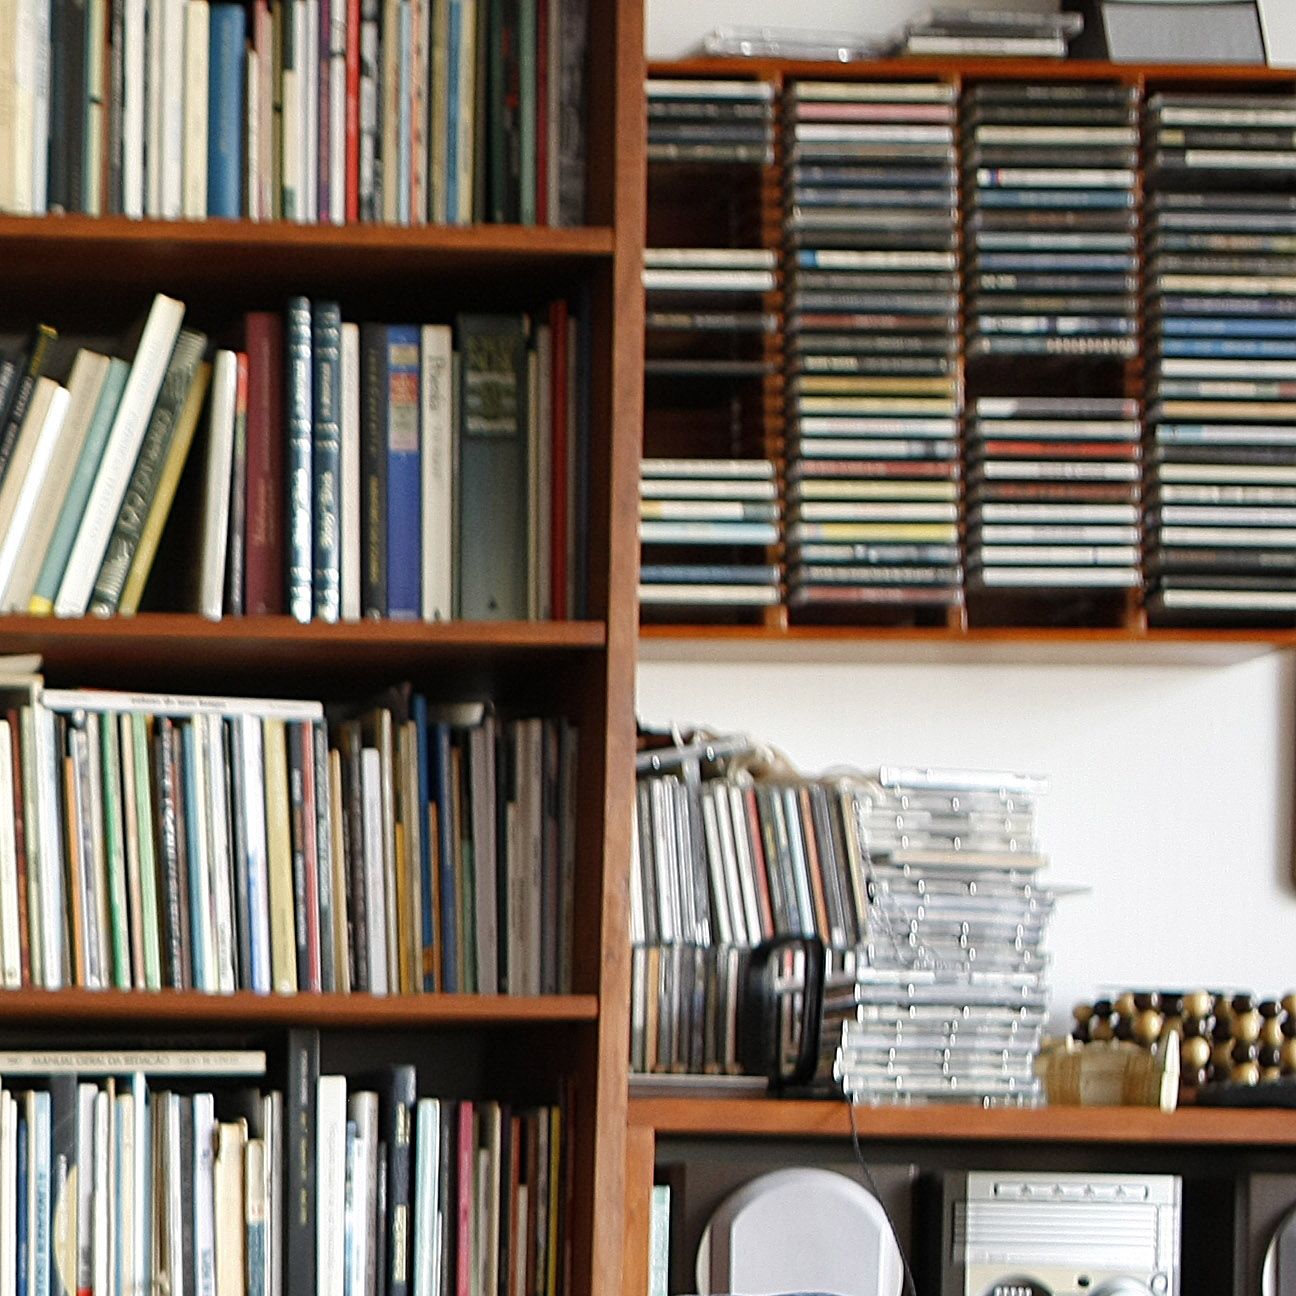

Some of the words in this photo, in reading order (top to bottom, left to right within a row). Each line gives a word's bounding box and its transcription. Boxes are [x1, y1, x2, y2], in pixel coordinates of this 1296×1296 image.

[31, 1055, 74, 1066] MANUAL
[77, 1055, 105, 1066] GERAL
[108, 1055, 122, 1066] DA
